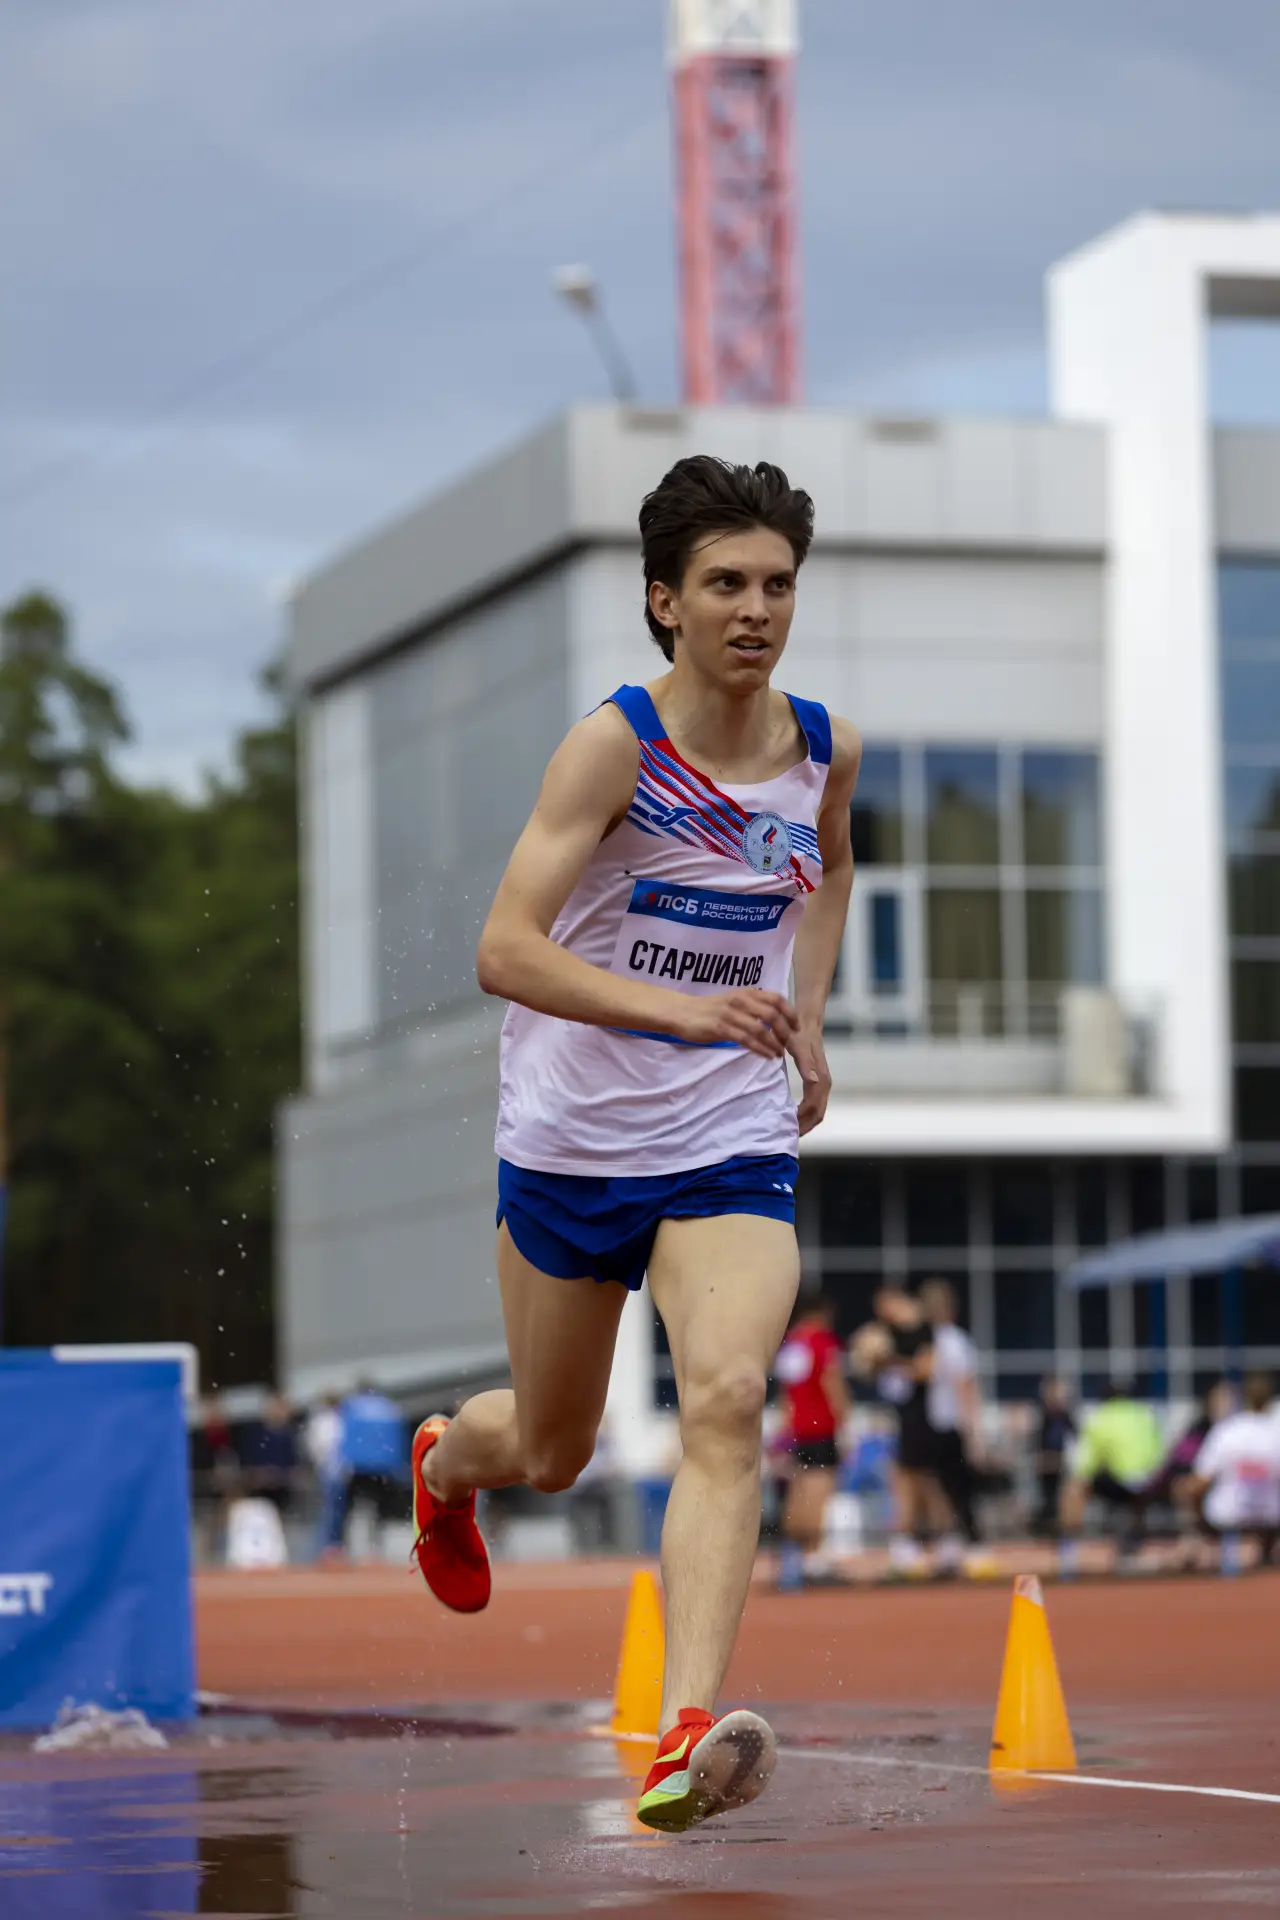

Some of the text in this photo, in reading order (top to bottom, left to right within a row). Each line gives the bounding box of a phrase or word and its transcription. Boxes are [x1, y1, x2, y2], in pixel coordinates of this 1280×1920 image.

[657, 894, 699, 915] ПСБ
[703, 901, 770, 914] ПЕРВЕНСТВО
[701, 909, 764, 922] РОССИИ U18
[628, 939, 764, 987] СТАРШИНОВ
